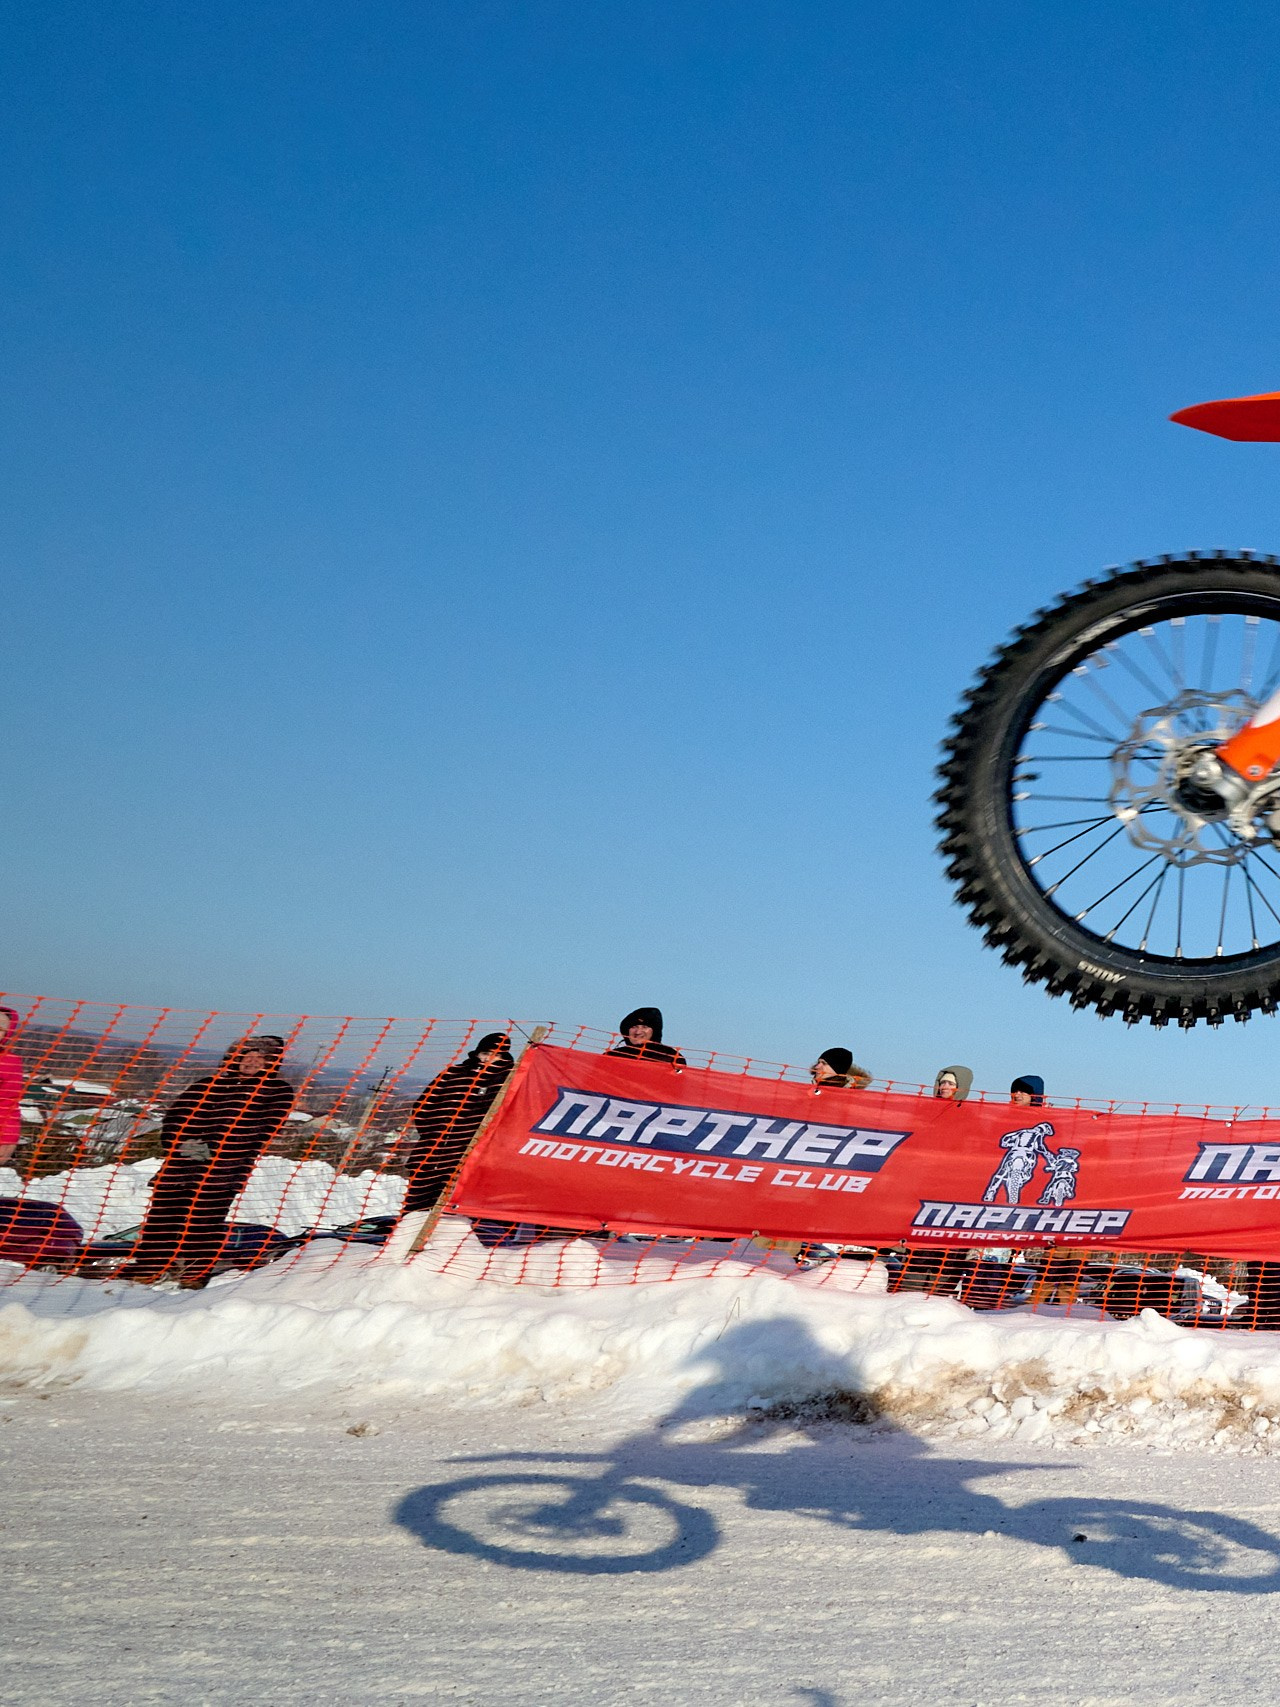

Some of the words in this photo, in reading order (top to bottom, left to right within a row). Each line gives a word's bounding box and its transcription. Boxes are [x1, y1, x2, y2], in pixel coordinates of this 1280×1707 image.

[538, 1091, 905, 1165] ПАРТНЕР
[518, 1138, 764, 1182] MOTORCYCLE
[770, 1169, 873, 1193] CLUB
[914, 1202, 1131, 1233] ПАРТНЕР
